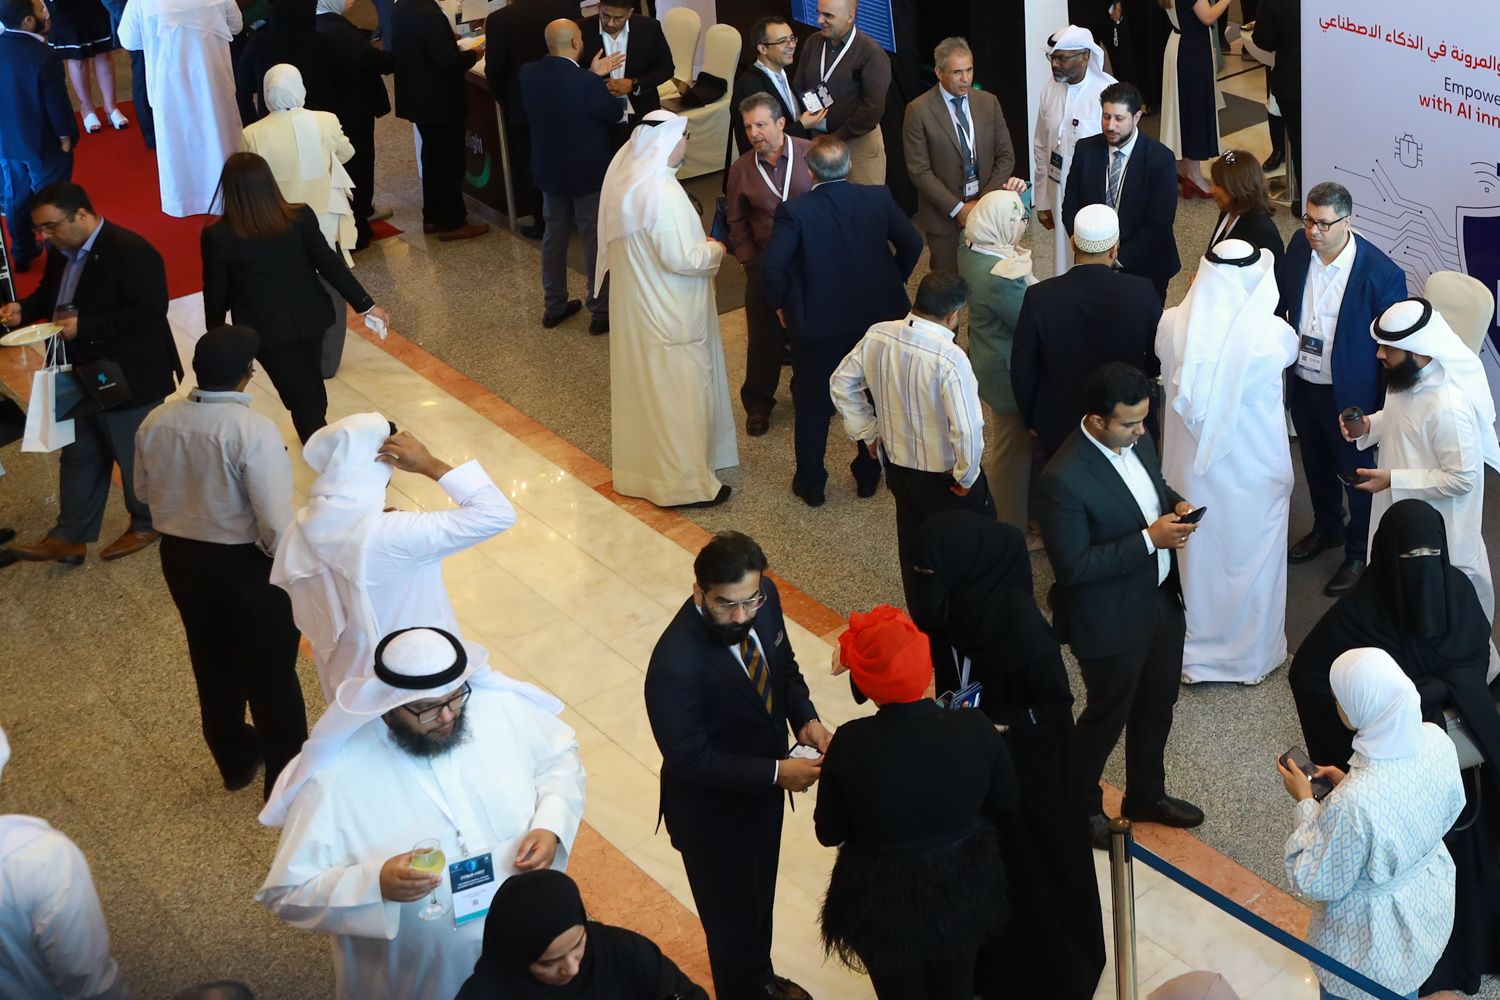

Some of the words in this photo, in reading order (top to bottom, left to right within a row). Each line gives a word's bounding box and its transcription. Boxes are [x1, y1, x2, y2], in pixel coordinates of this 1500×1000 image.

[1318, 14, 1381, 40] الاصطناعي
[1385, 29, 1423, 52] الذكاء
[1427, 40, 1447, 63] في
[1419, 94, 1452, 114] with
[1457, 102, 1472, 120] AI
